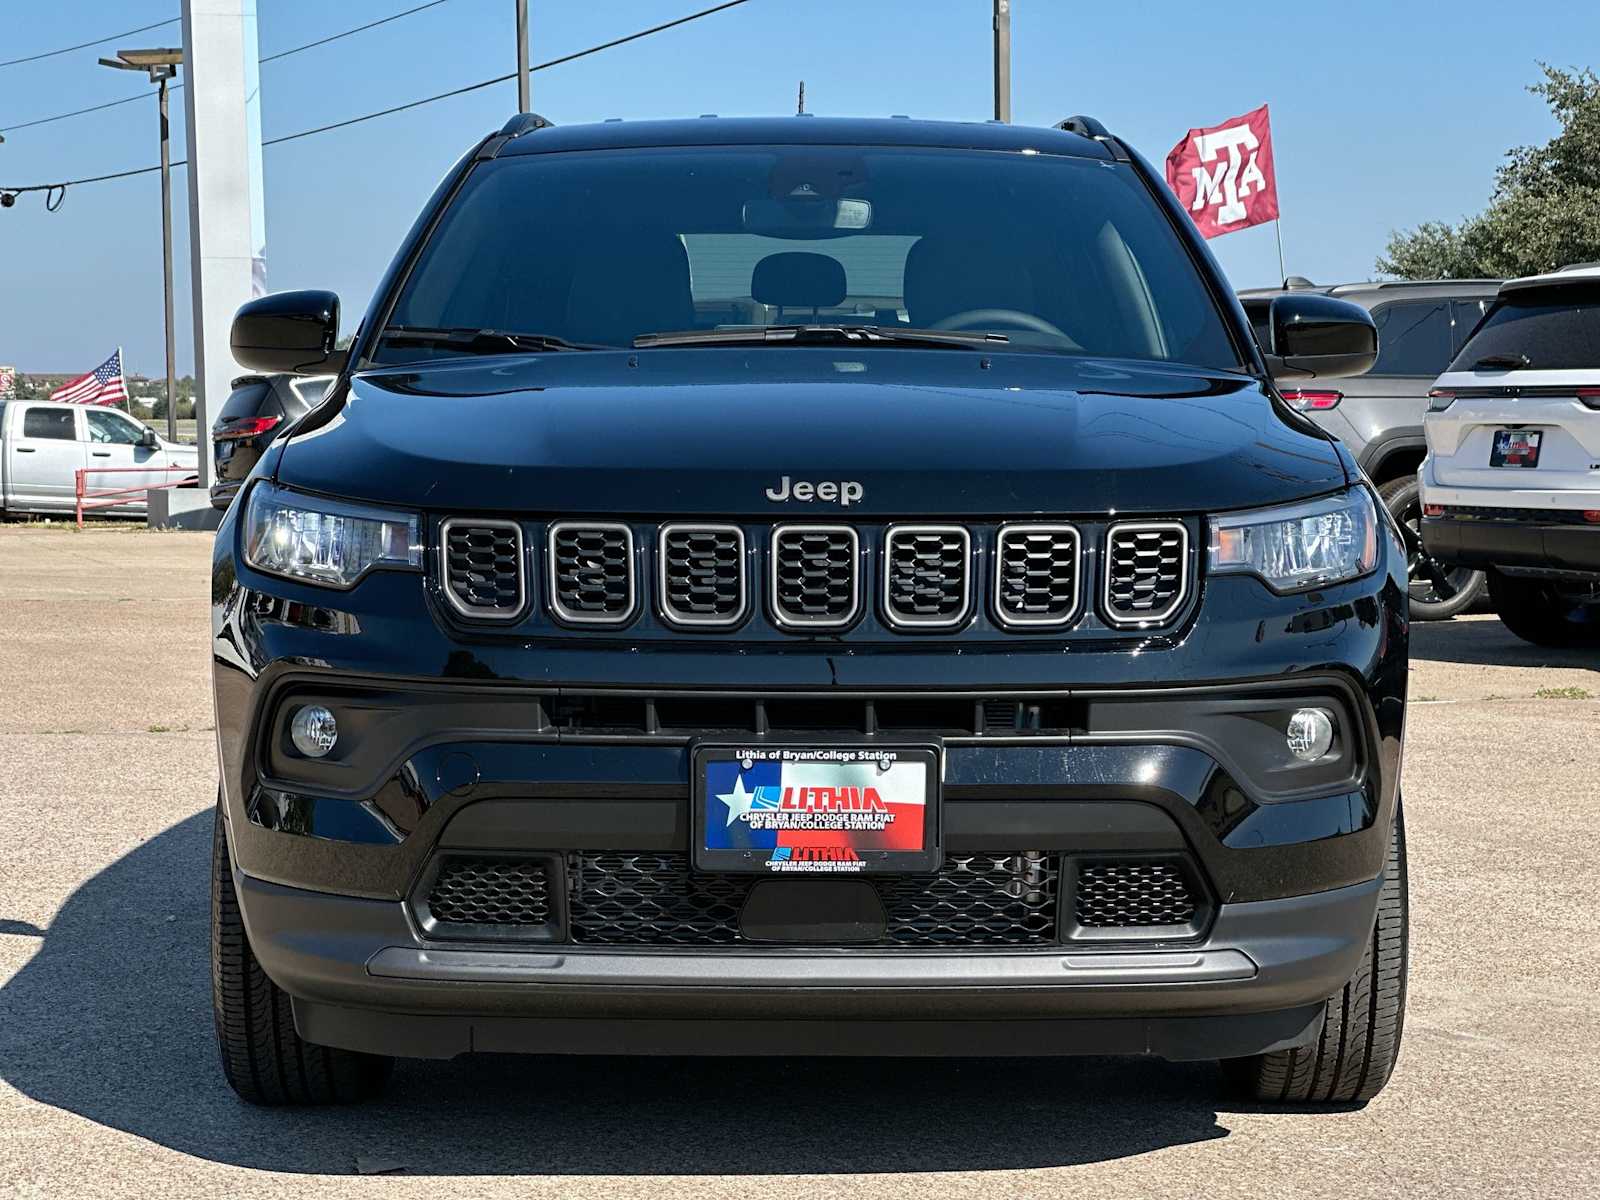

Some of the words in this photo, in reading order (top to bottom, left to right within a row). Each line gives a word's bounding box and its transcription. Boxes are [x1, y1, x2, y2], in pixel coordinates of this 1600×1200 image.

[766, 476, 864, 505] Jeep
[736, 750, 766, 760] Lithia
[768, 750, 781, 760] of
[783, 750, 856, 761] Bryan/College
[858, 751, 897, 761] Station
[781, 786, 887, 812] LITHIA
[740, 813, 789, 822] CHRYSLER
[790, 814, 813, 822] JEEP
[815, 814, 850, 822] DODGE
[851, 814, 874, 822] RAM
[875, 814, 896, 823] FIAT
[750, 821, 764, 830] OF
[765, 822, 843, 830] BRYAN/COLLEGE
[845, 821, 885, 830] STATION
[792, 847, 860, 861] LITHIA
